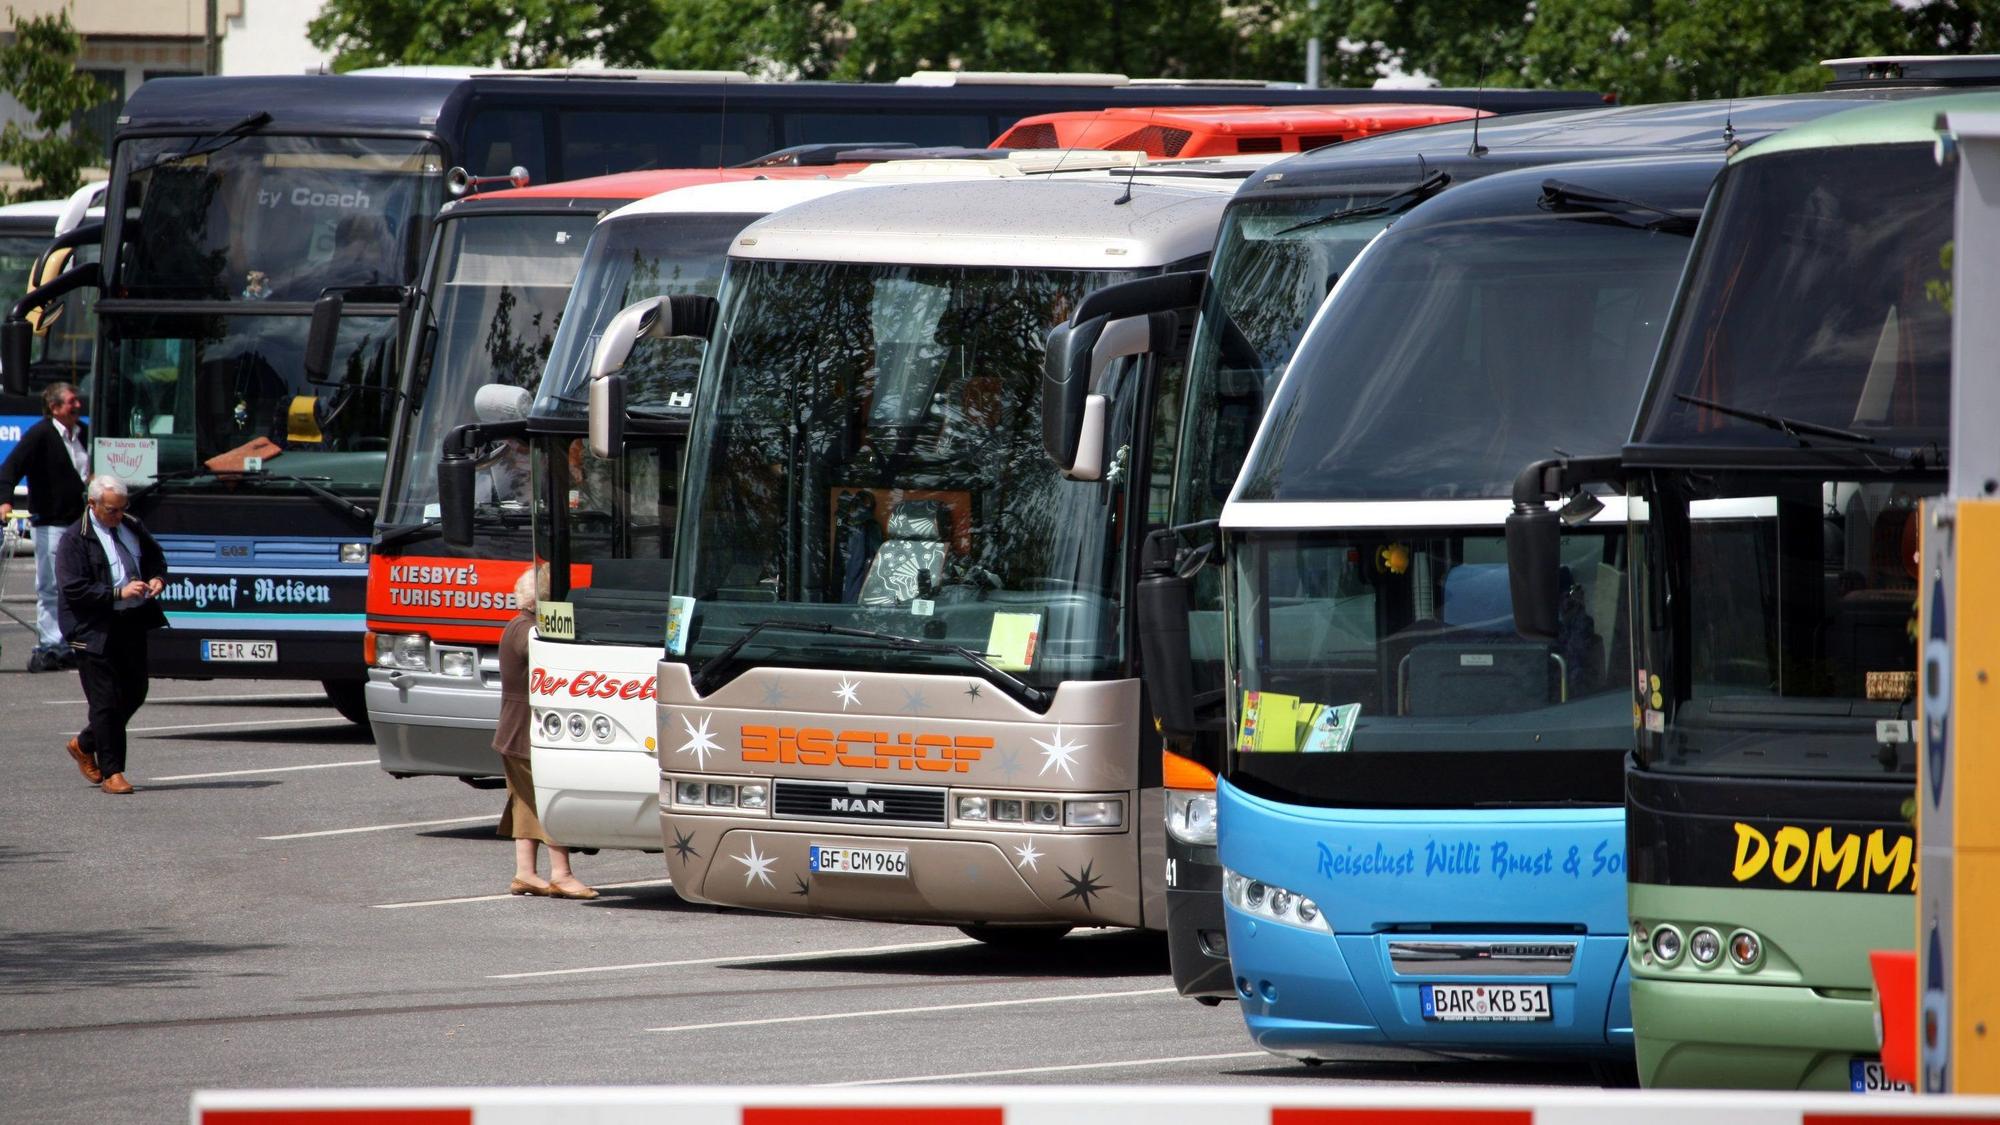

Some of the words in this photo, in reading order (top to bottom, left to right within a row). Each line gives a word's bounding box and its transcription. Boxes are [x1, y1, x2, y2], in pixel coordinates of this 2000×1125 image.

[291, 187, 370, 208] Coach
[389, 563, 479, 585] KIESBYE's
[156, 577, 237, 608] andgraf
[254, 577, 331, 604] Reisen
[210, 643, 227, 658] EE
[236, 643, 244, 658] R
[251, 644, 274, 659] 457
[530, 667, 569, 697] Der
[568, 670, 656, 701] Elset
[830, 797, 885, 814] MAN
[820, 850, 841, 869] GF
[851, 851, 872, 871] CM
[875, 853, 905, 873] 966
[1316, 840, 1415, 881] Reiselust
[1424, 839, 1481, 878] Willi
[1490, 840, 1553, 881] Brust
[1562, 844, 1581, 879] &
[1732, 821, 1919, 893] DOMM
[1434, 989, 1476, 1013] BAR
[1488, 989, 1517, 1013] KB
[1520, 990, 1547, 1013] 51
